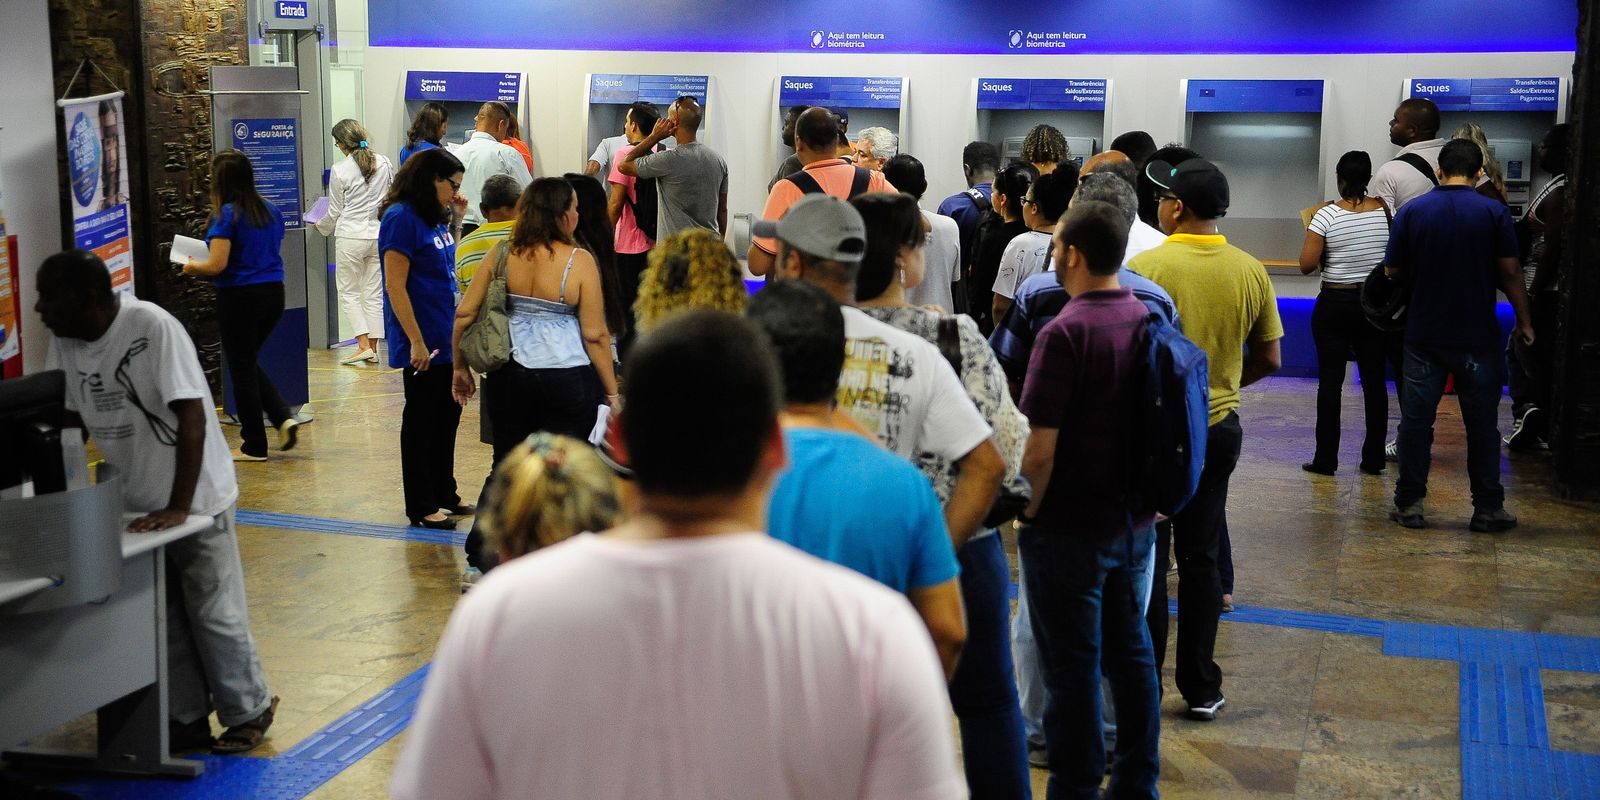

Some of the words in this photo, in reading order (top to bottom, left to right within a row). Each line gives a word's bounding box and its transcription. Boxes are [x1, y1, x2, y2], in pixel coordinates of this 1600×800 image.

[280, 2, 305, 16] Entrada
[827, 31, 844, 40] Aqui
[1026, 31, 1044, 40] Aqui
[420, 83, 446, 92] Senha
[595, 78, 623, 88] Saques
[784, 80, 814, 91] Saques
[982, 82, 1012, 93] Saques
[1415, 82, 1450, 94] Saques
[253, 130, 294, 139] SEGURANÇA
